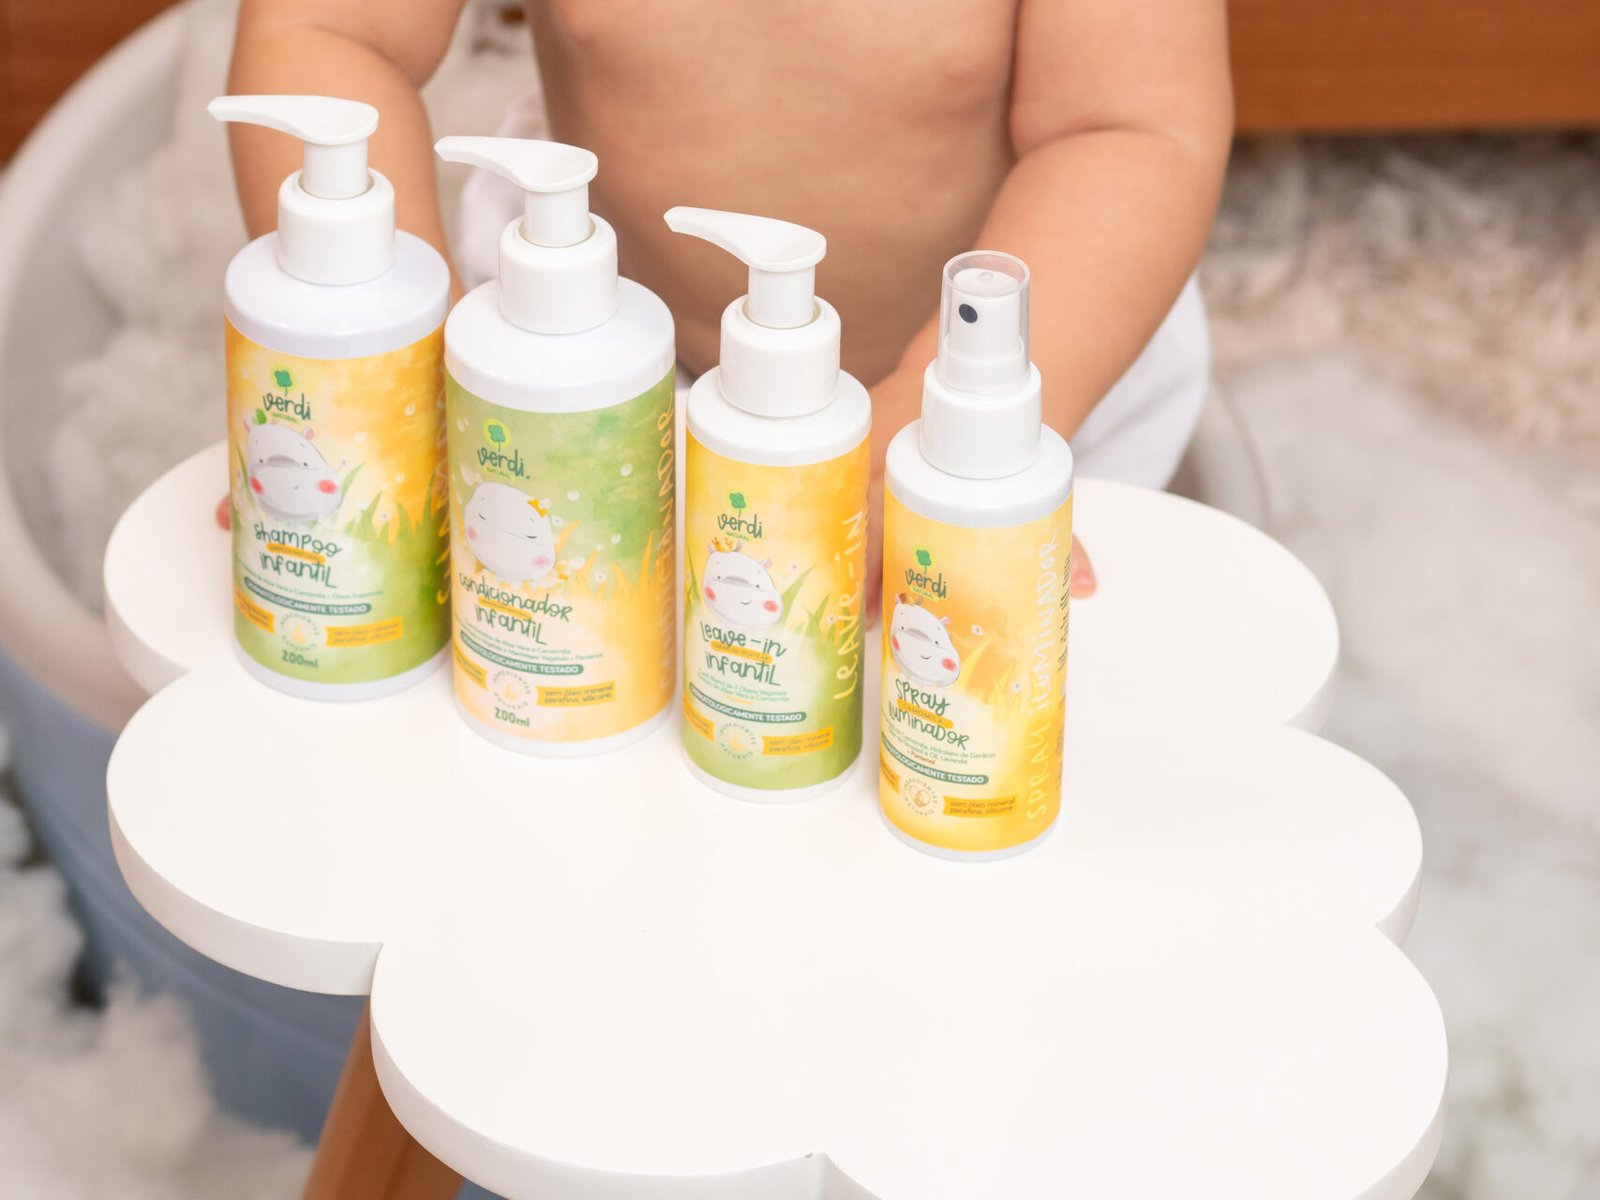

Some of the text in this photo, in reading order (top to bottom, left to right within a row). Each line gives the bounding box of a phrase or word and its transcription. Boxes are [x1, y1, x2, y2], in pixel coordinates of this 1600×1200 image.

[263, 393, 311, 420] verdi
[717, 513, 763, 539] verdi
[905, 569, 947, 598] verdi
[329, 604, 367, 614] TESTADO
[281, 650, 319, 668] 200ml
[539, 665, 579, 674] TESTADO
[494, 706, 530, 727] 200ml
[766, 713, 802, 722] TESTADO
[947, 774, 984, 784] TESTADO
